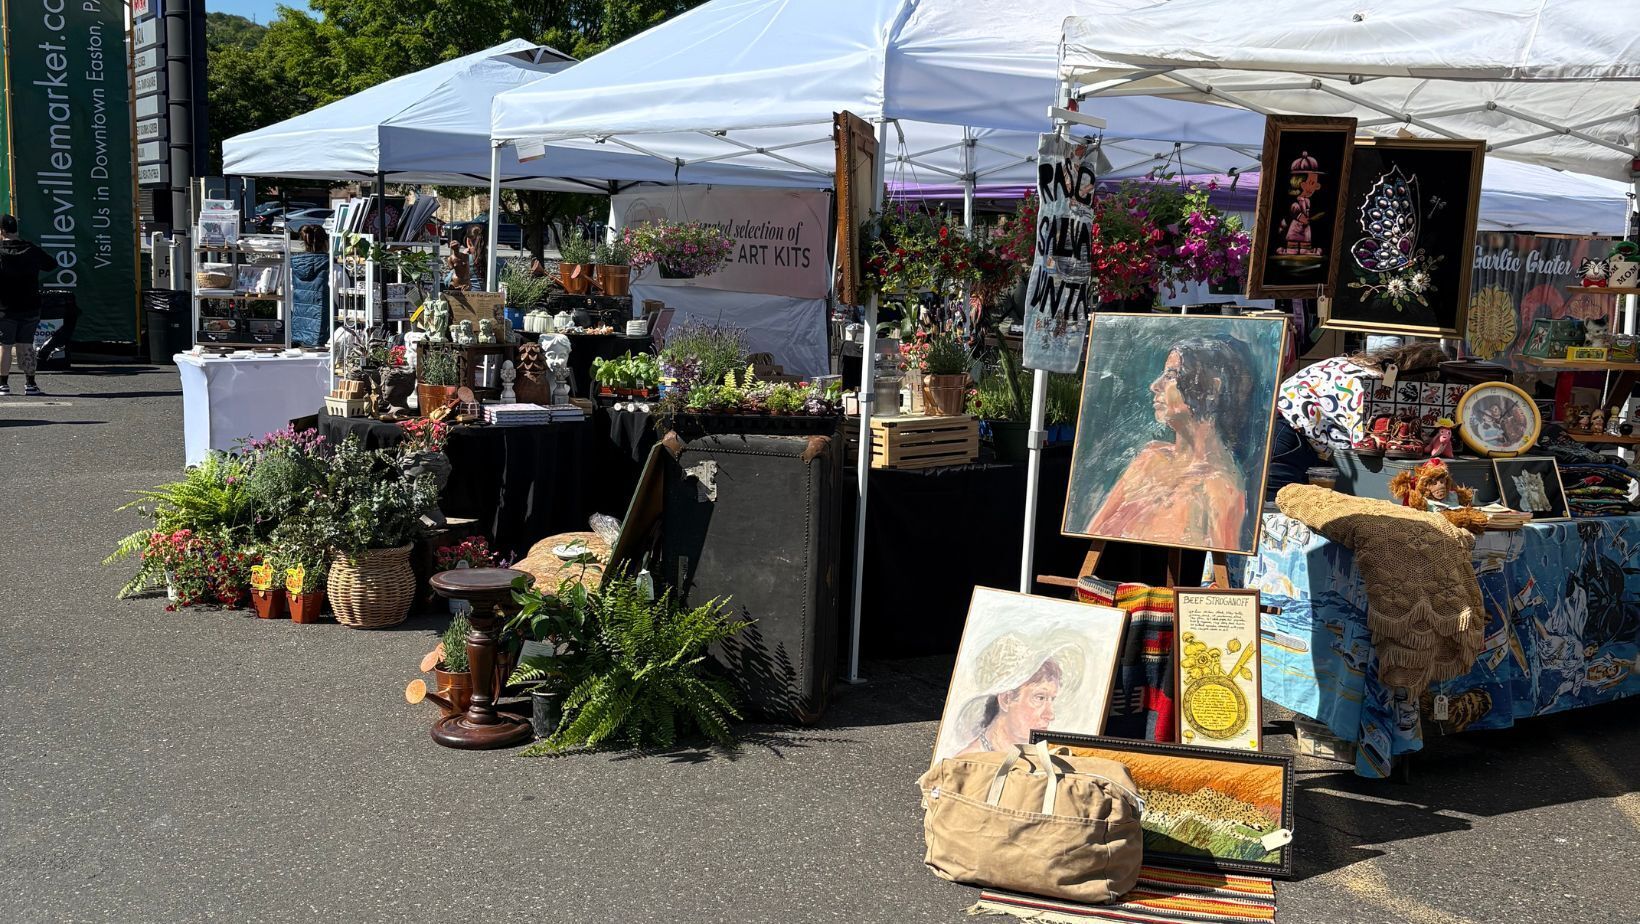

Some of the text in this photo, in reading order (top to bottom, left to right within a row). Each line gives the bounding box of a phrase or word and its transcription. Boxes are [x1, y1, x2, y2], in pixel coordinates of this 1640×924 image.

[86, 20, 104, 81] Easton,
[90, 88, 109, 179] Downtown
[93, 186, 110, 201] in
[92, 207, 111, 228] Us
[734, 220, 784, 241] selection
[787, 221, 803, 245] of
[94, 235, 112, 269] Visit
[738, 244, 768, 265] ART
[774, 245, 811, 268] KITS
[1473, 245, 1573, 275] Garlic Grater
[1616, 264, 1638, 285] MOM
[1183, 595, 1204, 604] BEEF
